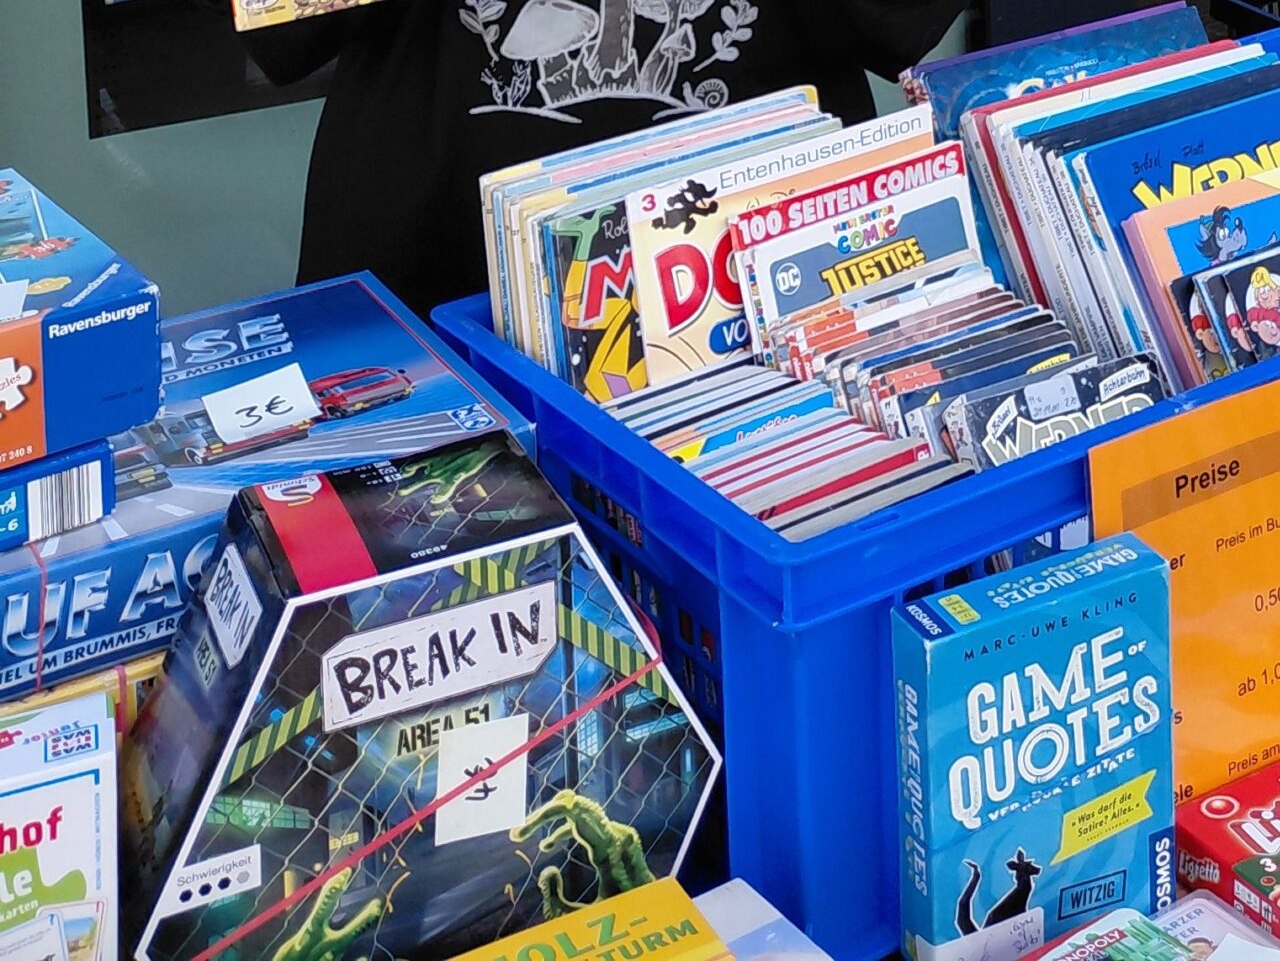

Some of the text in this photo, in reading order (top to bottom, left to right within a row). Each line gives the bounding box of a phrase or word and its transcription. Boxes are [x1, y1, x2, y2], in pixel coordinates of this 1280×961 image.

[719, 116, 923, 190] Entenhausen-Edition
[641, 193, 657, 213] 3
[737, 150, 961, 246] 100 SEITEN COMICS
[837, 218, 899, 255] COMIC
[819, 235, 927, 299] JUSTICE
[48, 301, 153, 339] Ravensburger
[183, 344, 284, 380] MONETEN
[1102, 368, 1148, 395] Achterbahn
[235, 394, 294, 429] 3€
[1174, 457, 1242, 500] Preise
[1215, 530, 1247, 554] Preis
[1248, 525, 1264, 540] im
[991, 570, 1076, 610] QUOTES
[904, 603, 943, 637] KOSMOS
[963, 592, 1138, 662] MARC-UWE KLING
[28, 626, 154, 676] UM BRUMMIS,
[332, 598, 541, 716] BREAK IN
[966, 625, 1148, 746] GAME OF
[1236, 677, 1257, 699] ab
[396, 713, 454, 757] AREA
[948, 674, 1161, 831] QUOTES
[1085, 747, 1137, 780] ZITATE
[1227, 752, 1260, 778] Preis
[1095, 790, 1133, 819] darf die
[1077, 815, 1109, 839] Satire?
[176, 854, 252, 888] Schwierigkeit
[1178, 850, 1221, 885] Ligretto
[1070, 880, 1116, 911] WITZIG
